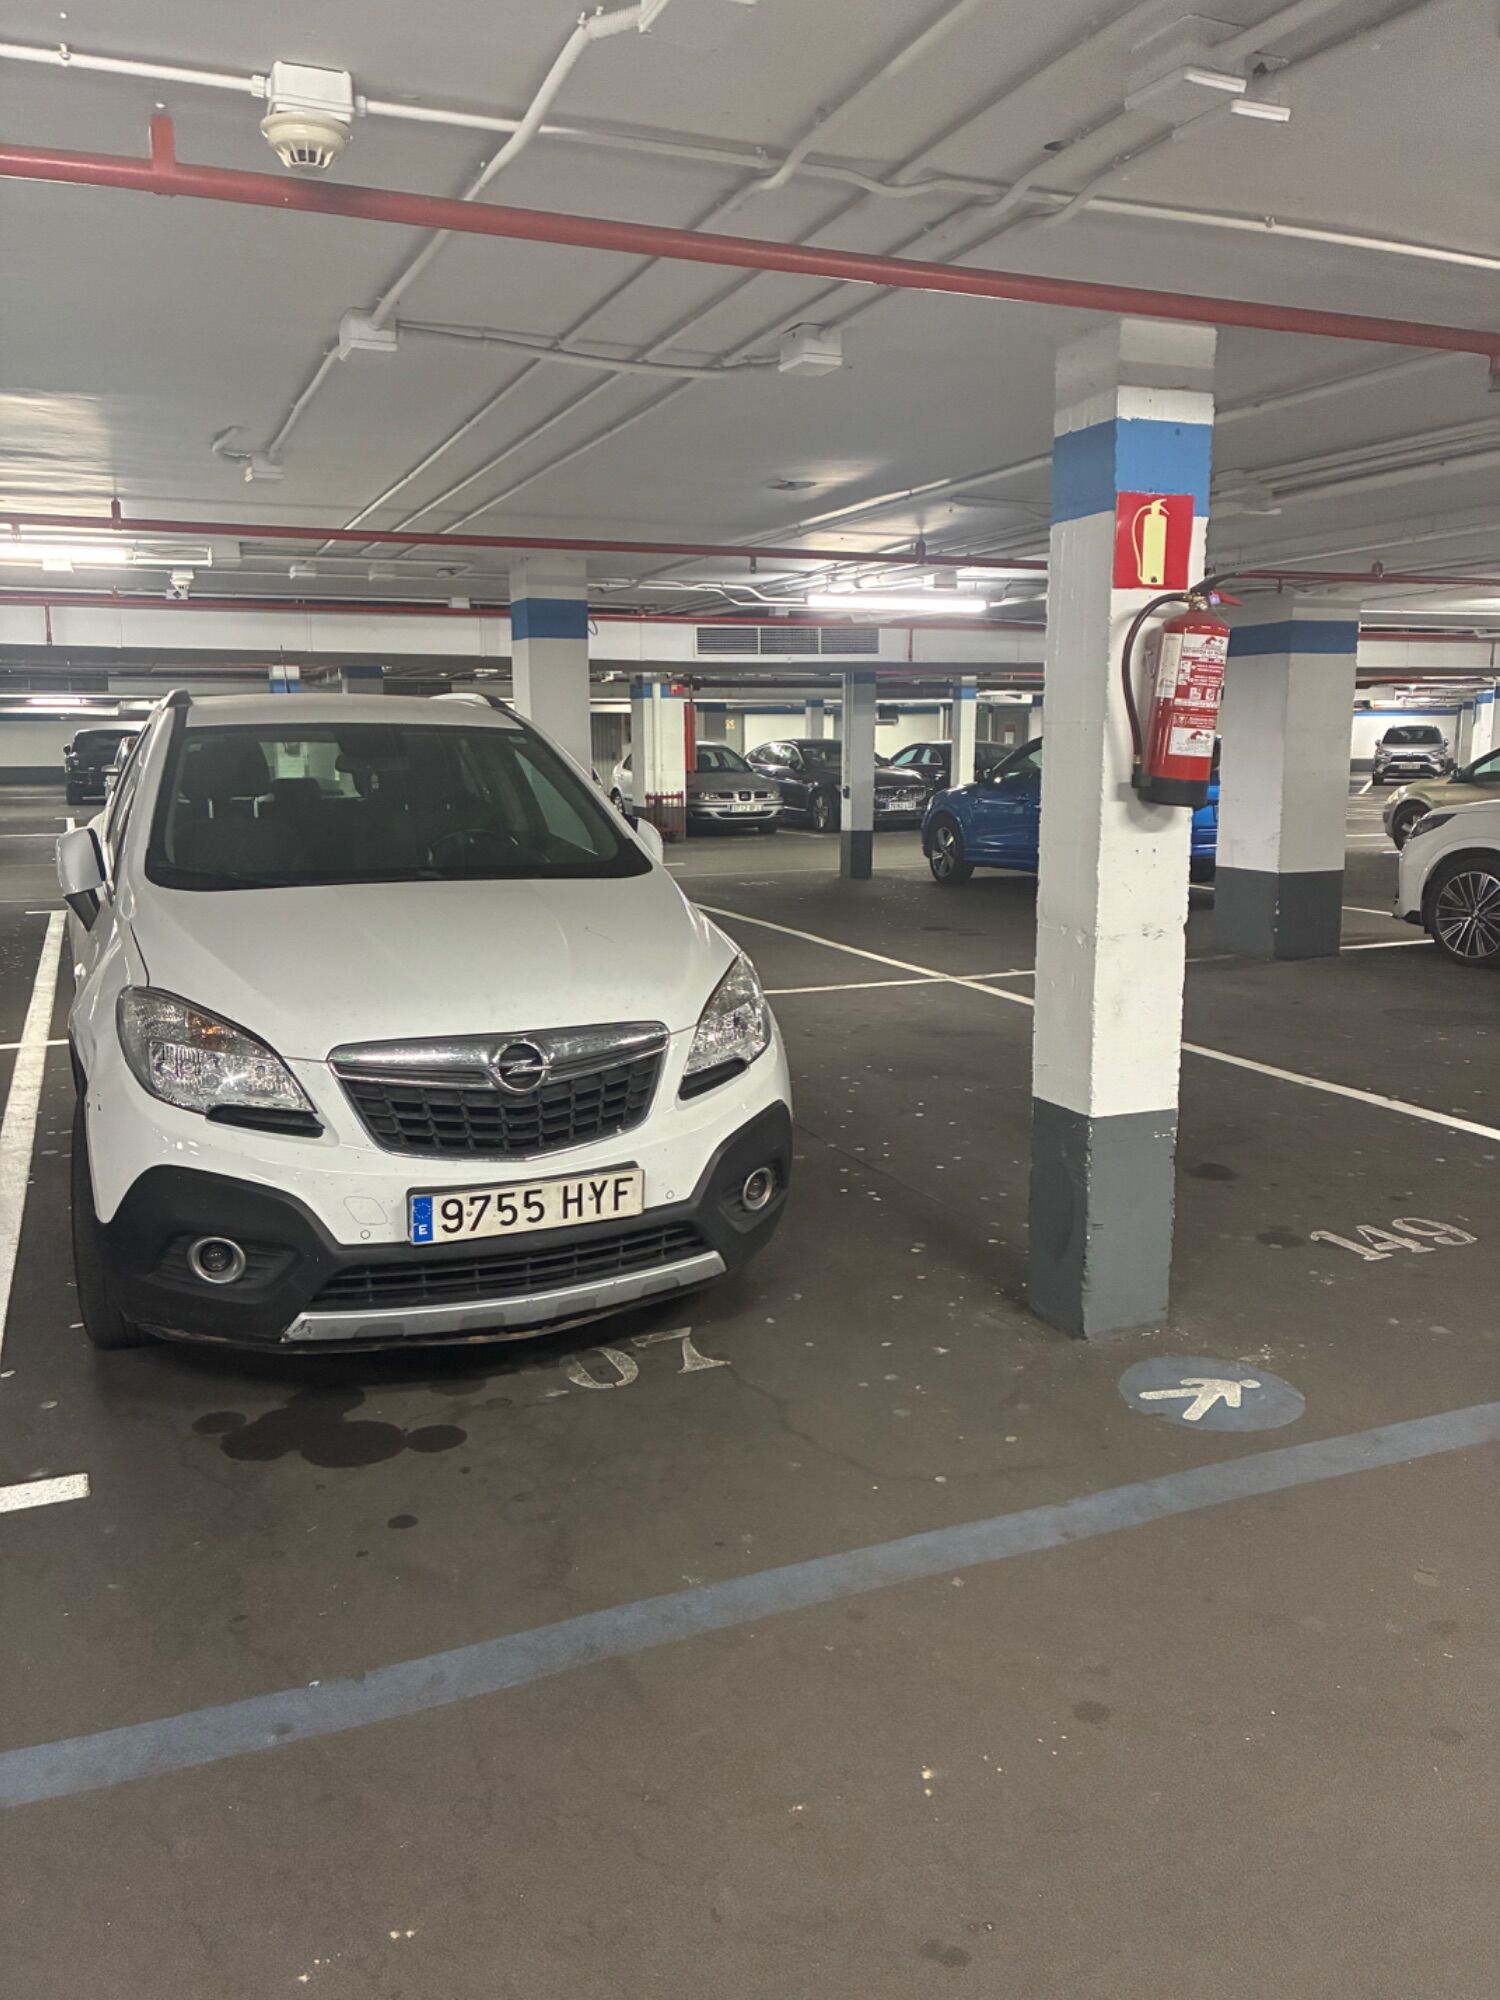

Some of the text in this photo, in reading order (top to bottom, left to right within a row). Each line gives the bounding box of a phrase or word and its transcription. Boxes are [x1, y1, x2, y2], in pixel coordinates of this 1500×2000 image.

[418, 1176, 634, 1236] E 9755 HYF
[1310, 1216, 1478, 1262] 149
